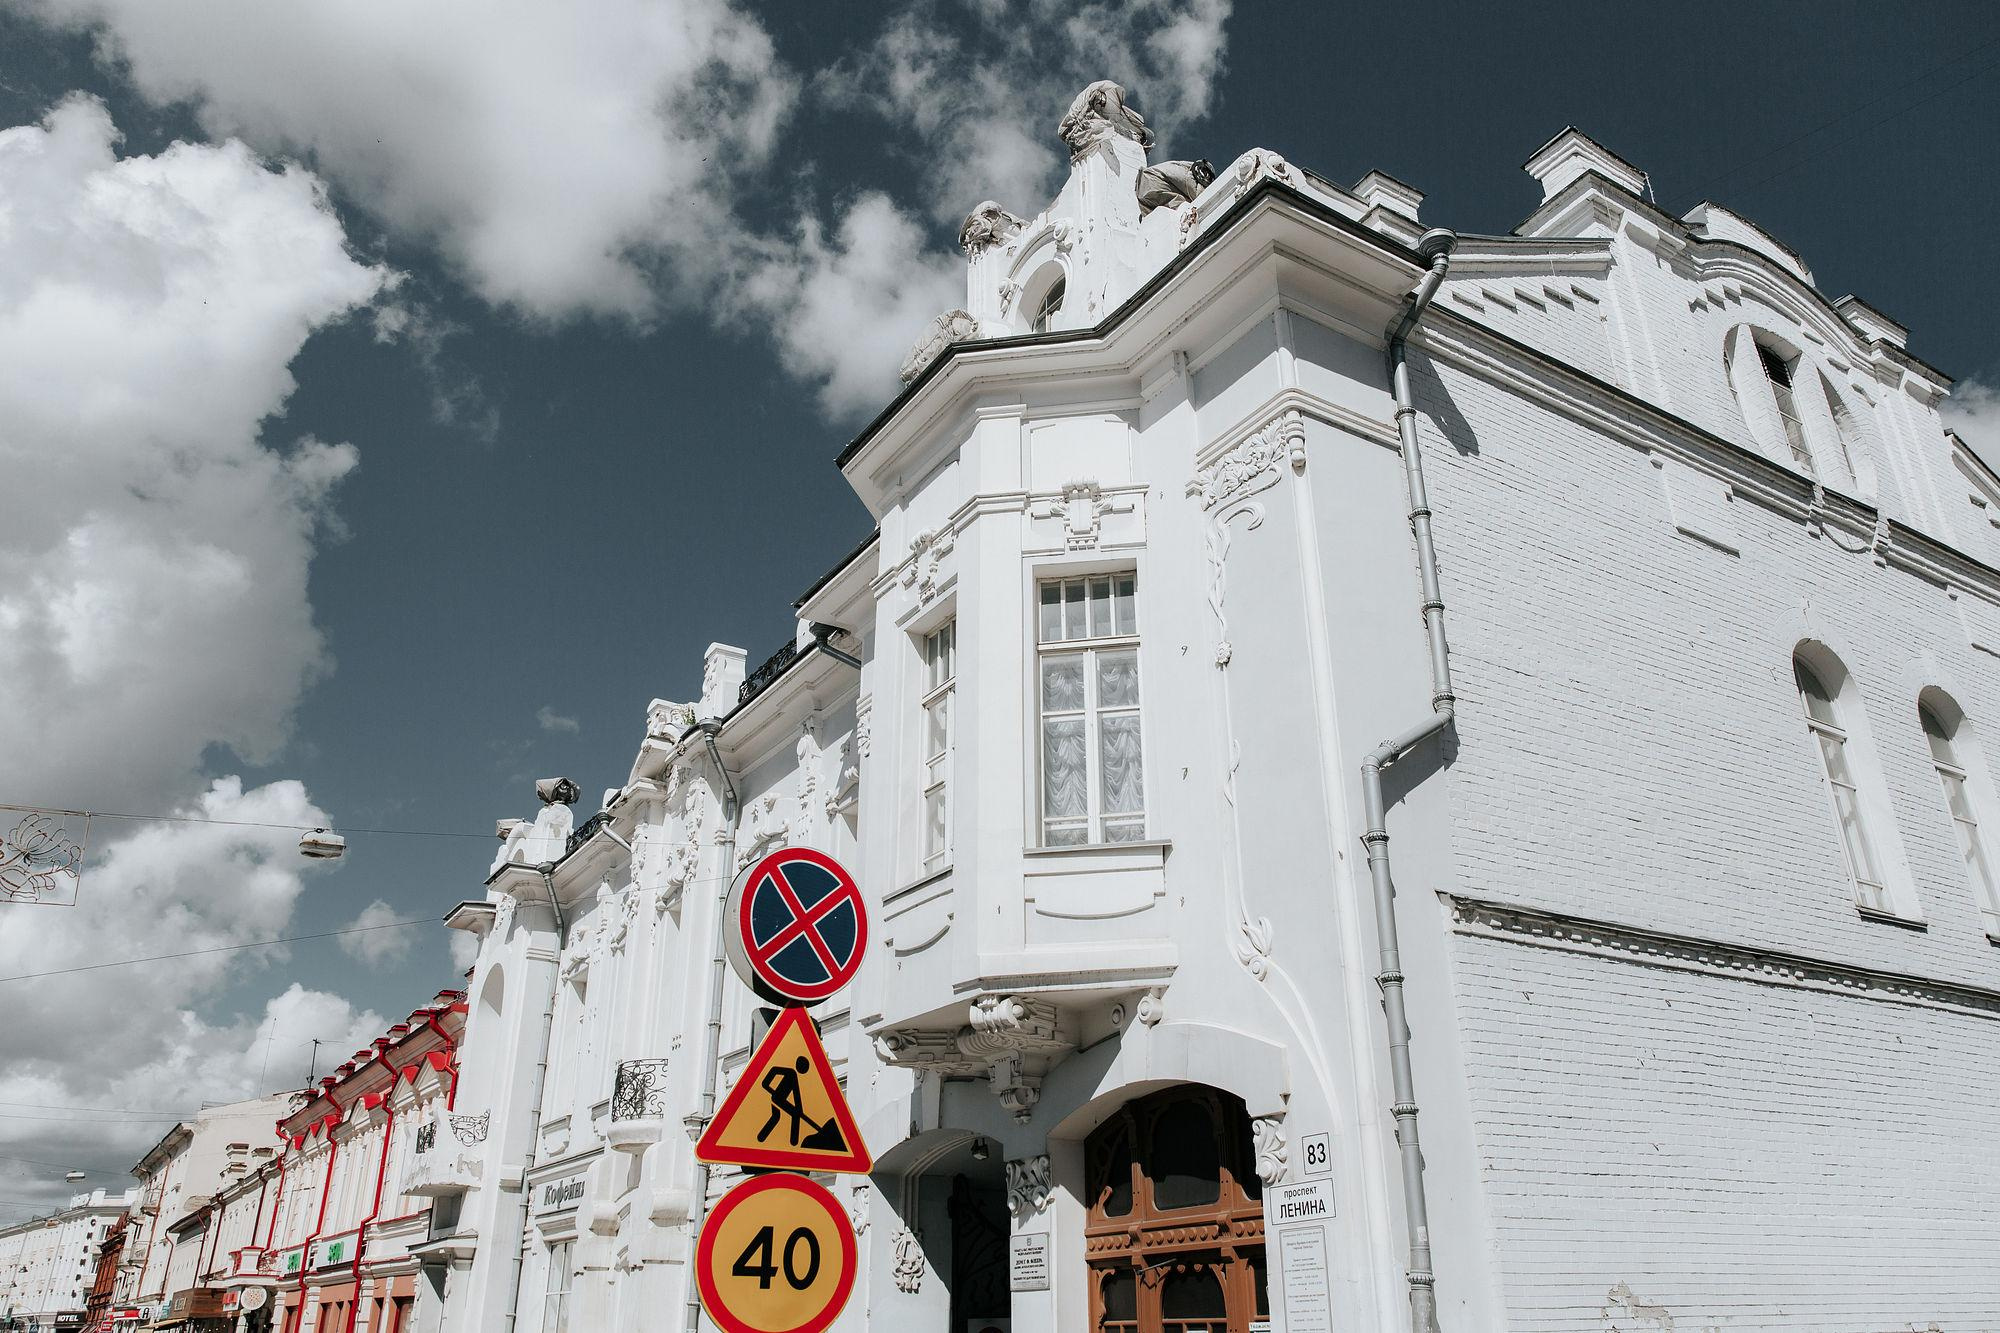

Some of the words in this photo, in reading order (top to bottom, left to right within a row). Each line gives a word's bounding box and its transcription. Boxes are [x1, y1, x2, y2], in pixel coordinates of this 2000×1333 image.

[1308, 1143, 1326, 1165] 83
[1284, 1187, 1317, 1200] проспект
[1280, 1199, 1326, 1218] ЛЕНИНА
[732, 1226, 820, 1290] 40
